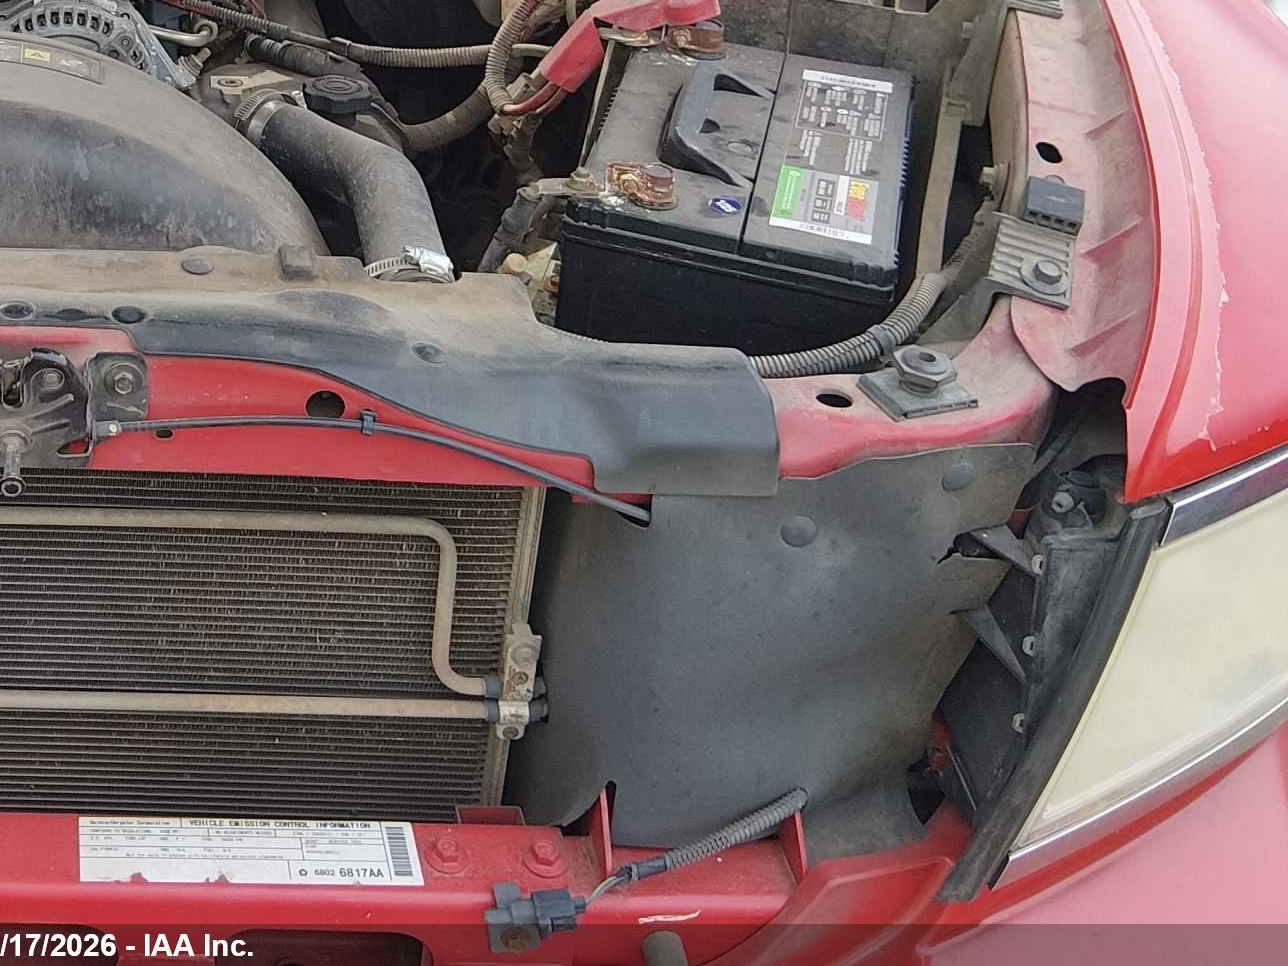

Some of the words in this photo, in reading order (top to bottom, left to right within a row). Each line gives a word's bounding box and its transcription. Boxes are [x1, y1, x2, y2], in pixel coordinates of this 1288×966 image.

[189, 819, 224, 827] VEHICLE
[229, 820, 270, 828] EMISSION
[314, 869, 335, 877] 6802
[339, 867, 384, 879] 6817AA
